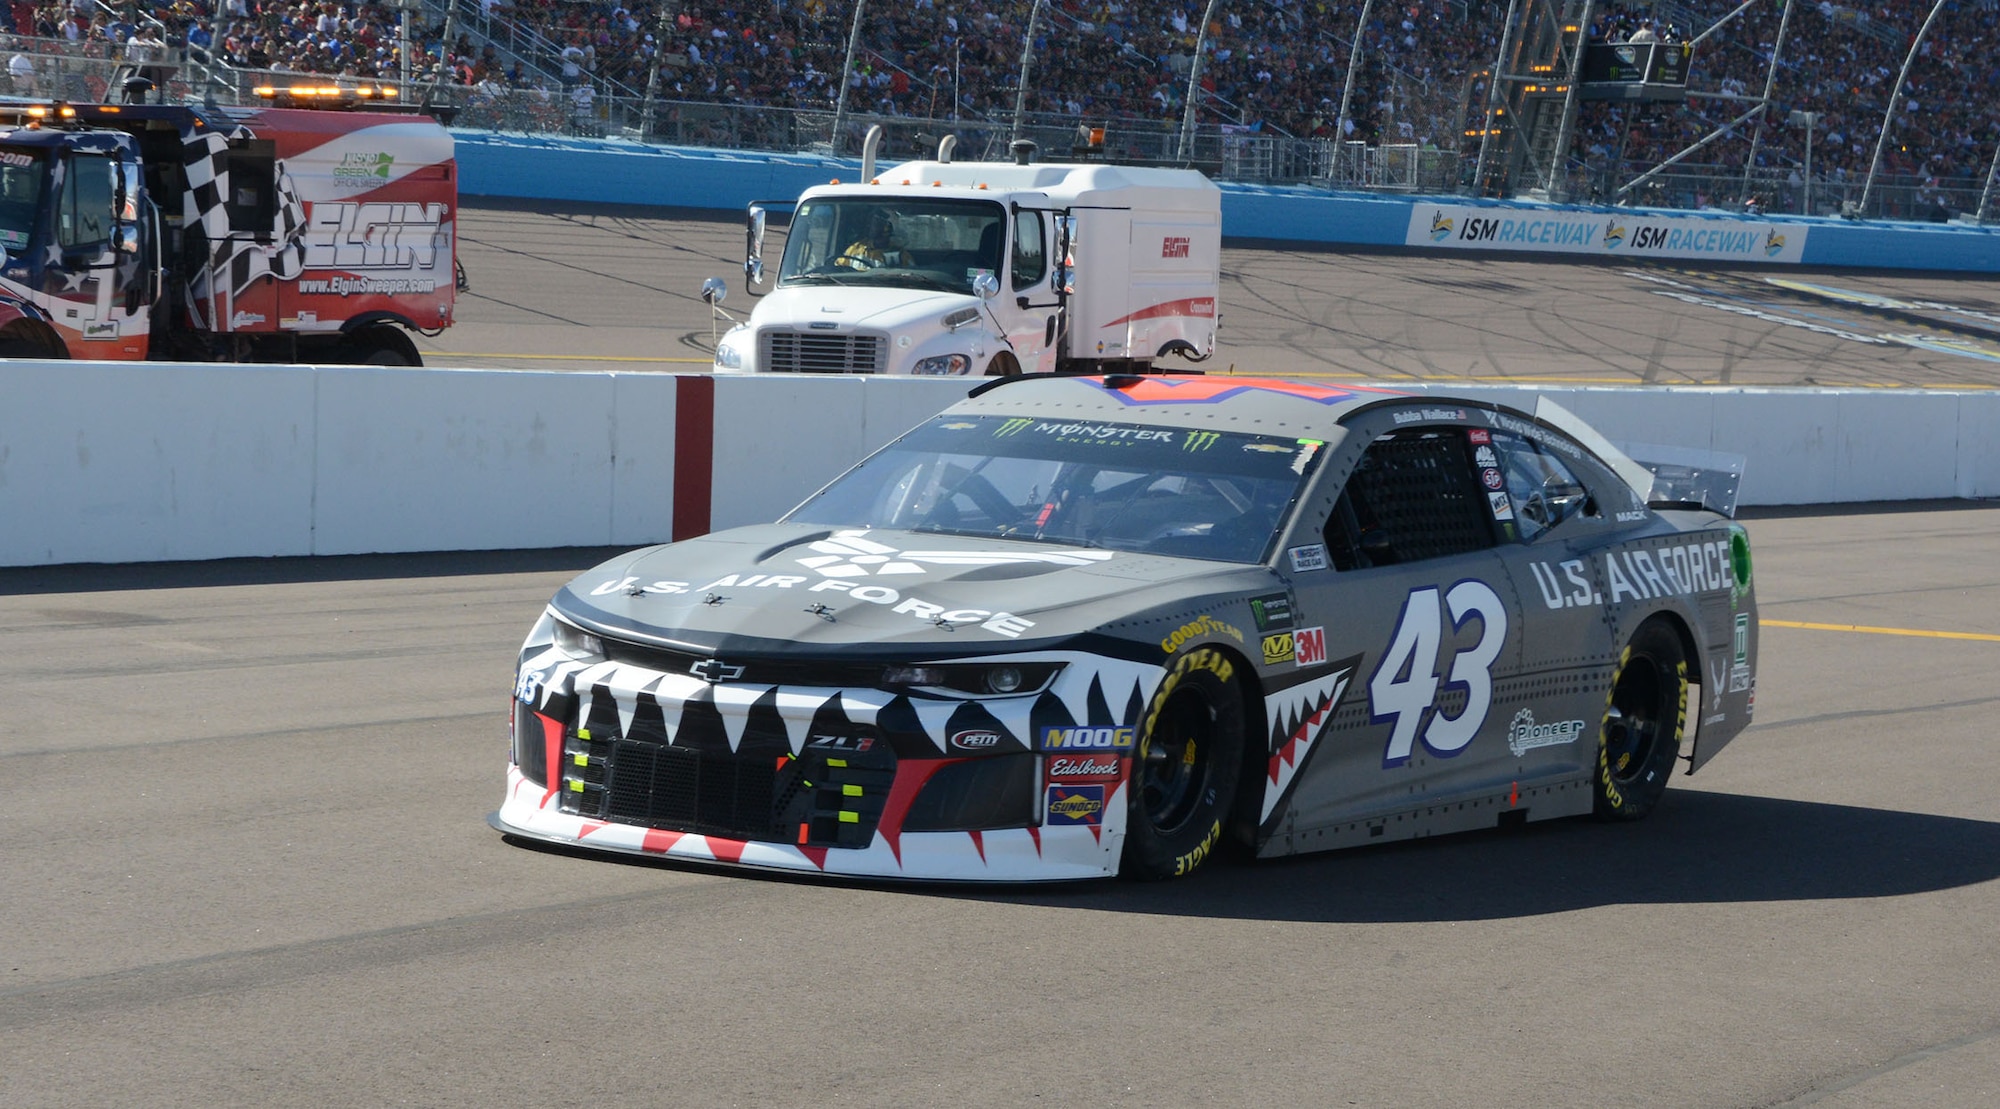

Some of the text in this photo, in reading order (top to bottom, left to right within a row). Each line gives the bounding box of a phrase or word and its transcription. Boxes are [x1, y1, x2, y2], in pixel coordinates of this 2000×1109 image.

[333, 167, 371, 177] GREEN
[304, 202, 443, 270] ELGIN
[1459, 217, 1598, 246] ISM RACEWAY
[1630, 226, 1759, 253] ISM RACEWAY
[1162, 237, 1190, 258] ELGIN
[298, 276, 435, 296] www.ElginSweeper.com
[1393, 408, 1457, 424] Bubba Wallace
[1055, 436, 1135, 447] ENERGY
[1616, 510, 1648, 522] MACK
[1529, 540, 1733, 610] U.S. AIR FORCE
[695, 574, 808, 593] AIR
[808, 579, 1037, 639] FORCE
[1296, 629, 1325, 664] 3M
[1367, 578, 1508, 770] 43
[515, 668, 546, 705] 43
[963, 734, 1001, 746] PETTY
[1045, 728, 1133, 748] MOOG
[1517, 720, 1585, 740] Pioneer
[808, 734, 876, 752] ZL1
[1050, 758, 1119, 776] Edelbrock
[1052, 801, 1100, 812] SUNOCO
[1174, 818, 1220, 876] EAGLE
